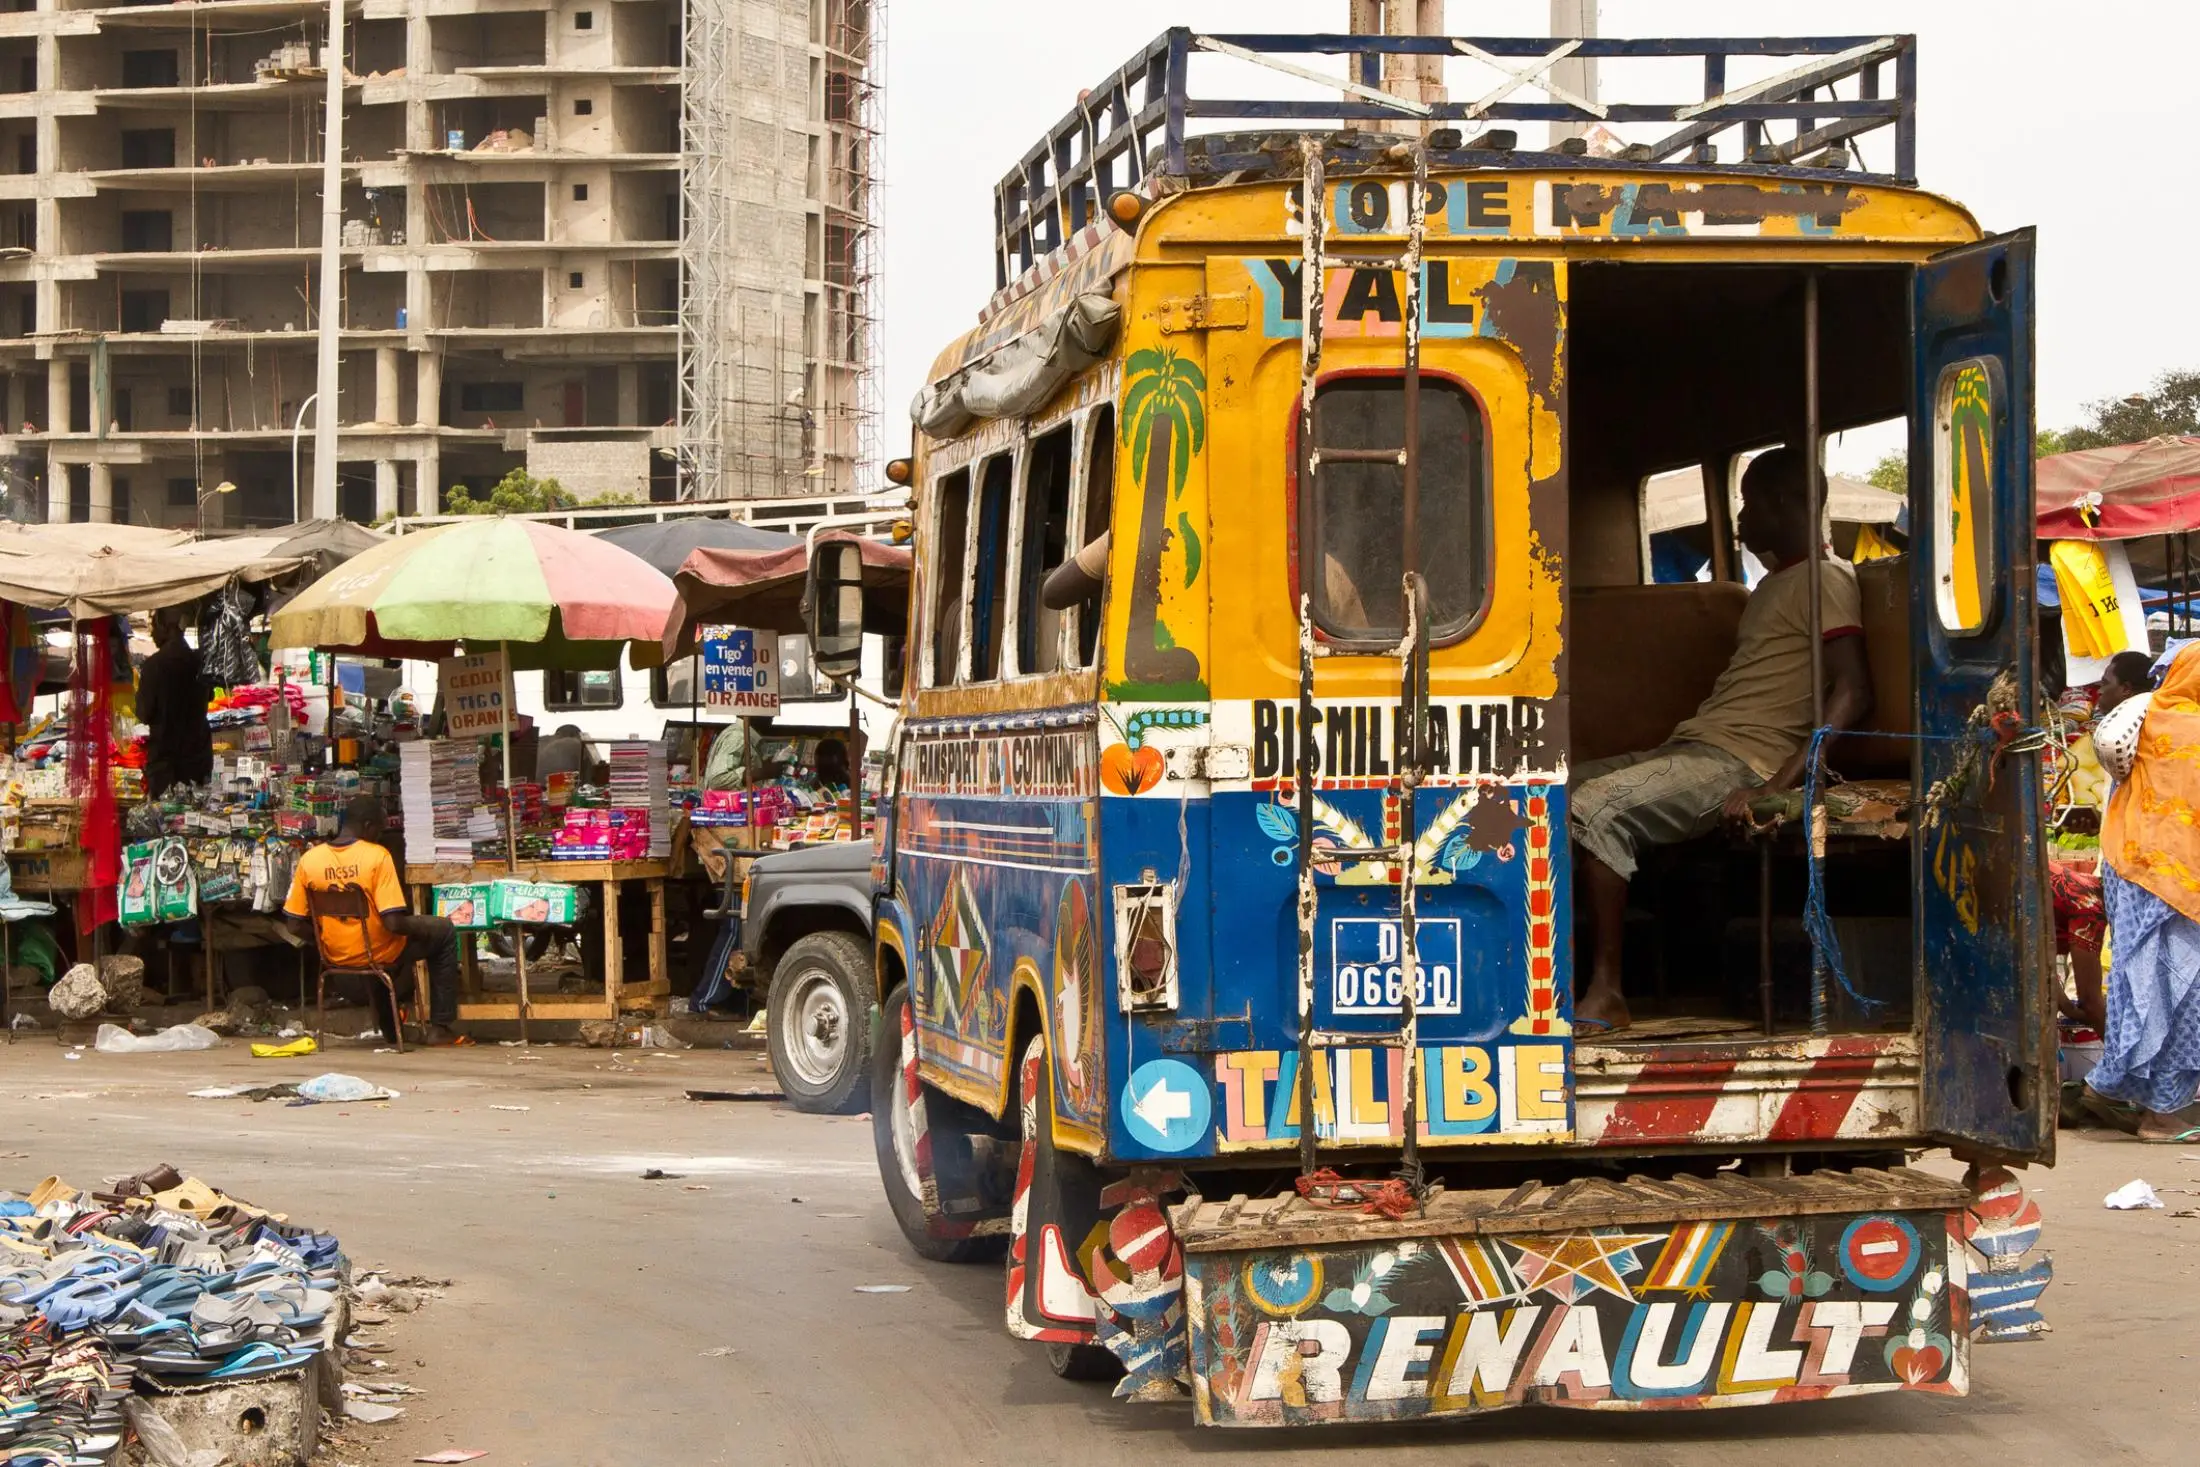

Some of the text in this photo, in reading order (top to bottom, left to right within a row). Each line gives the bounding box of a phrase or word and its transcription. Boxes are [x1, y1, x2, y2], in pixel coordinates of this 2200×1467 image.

[716, 646, 742, 663] Tigo
[706, 664, 753, 676] en vente
[724, 678, 737, 691] ici
[708, 690, 778, 708] ORANGE
[452, 708, 517, 730] ORANE
[1246, 1301, 1900, 1405] RENAULT
